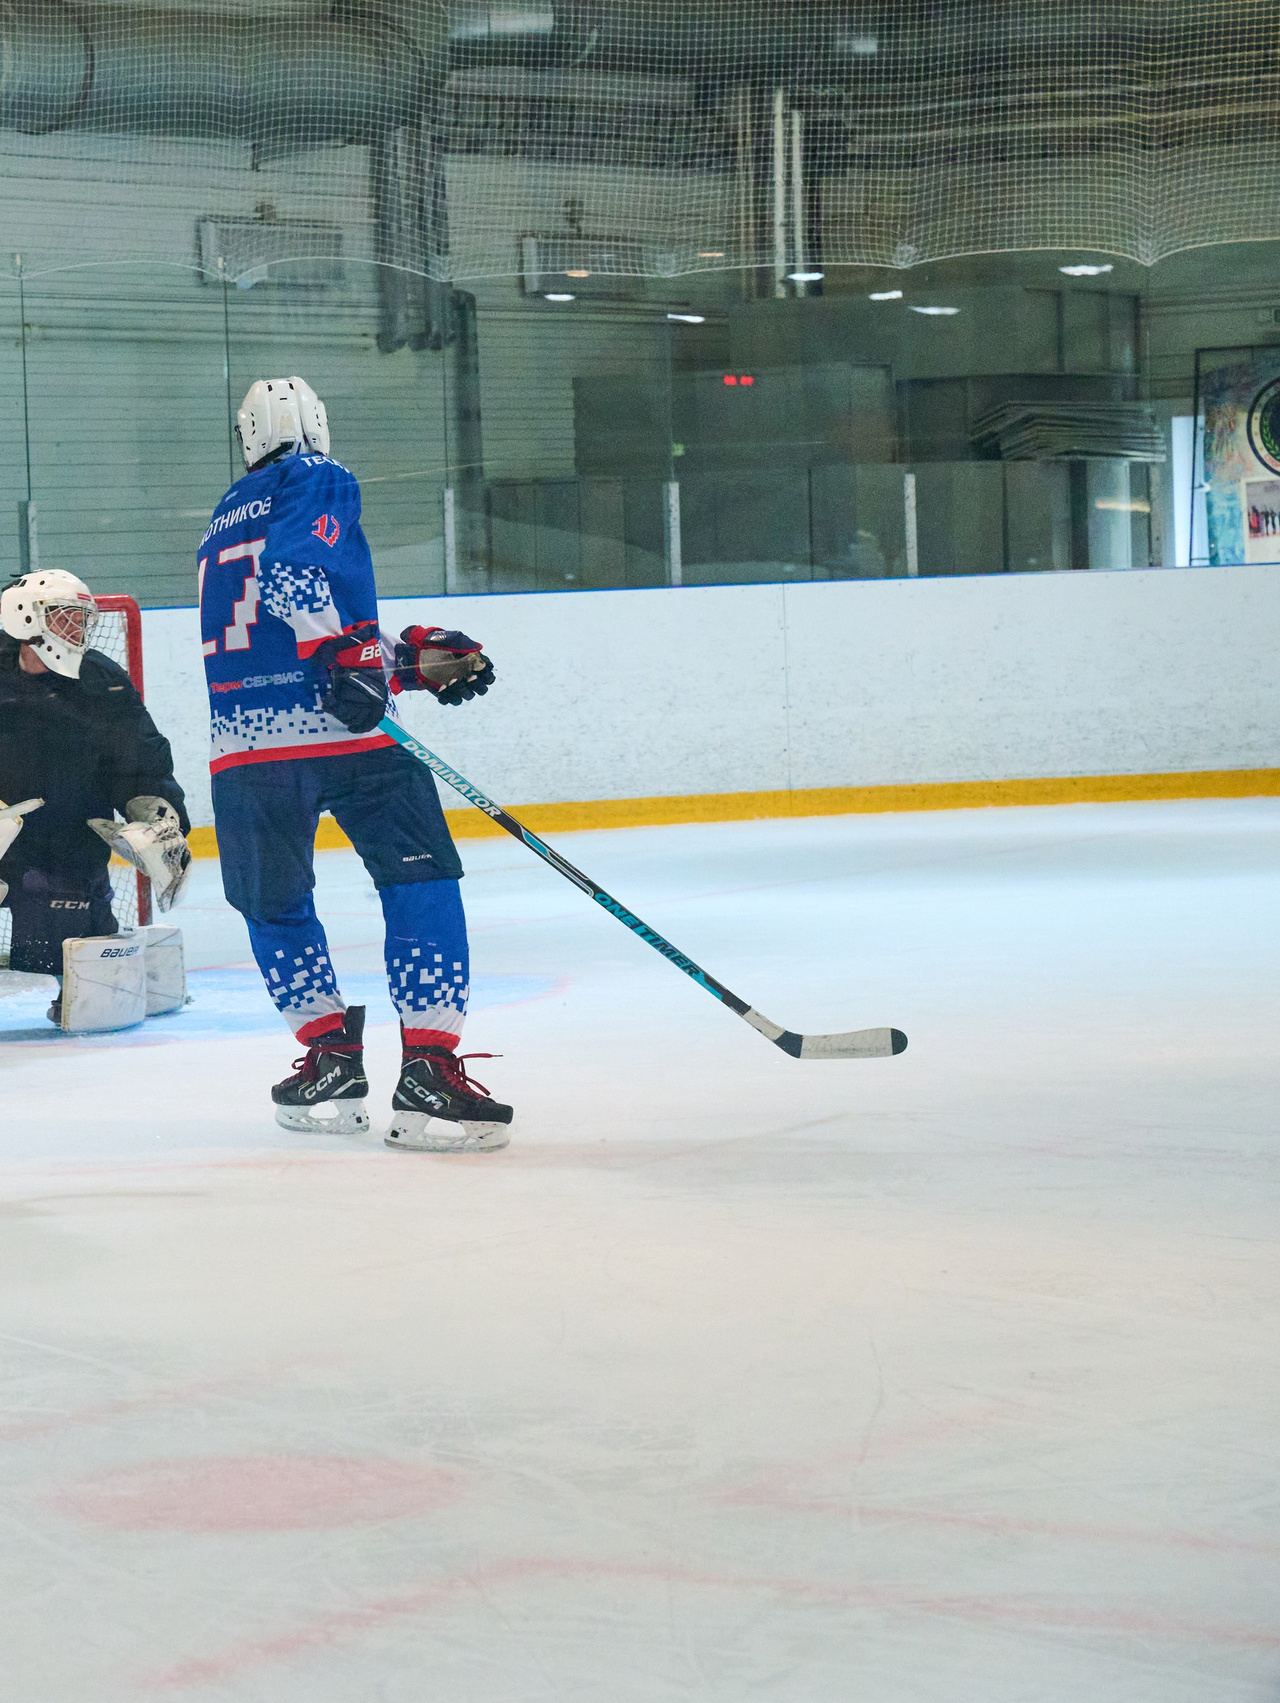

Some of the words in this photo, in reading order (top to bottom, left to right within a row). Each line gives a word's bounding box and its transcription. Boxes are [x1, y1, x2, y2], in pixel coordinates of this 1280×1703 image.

[401, 740, 502, 818] DOMINATOR
[49, 900, 91, 910] CCM
[100, 945, 140, 958] BAUER
[594, 892, 640, 927] ONE
[639, 927, 701, 977] TIMER
[304, 1065, 342, 1100] CCM
[403, 1076, 444, 1110] CCM
